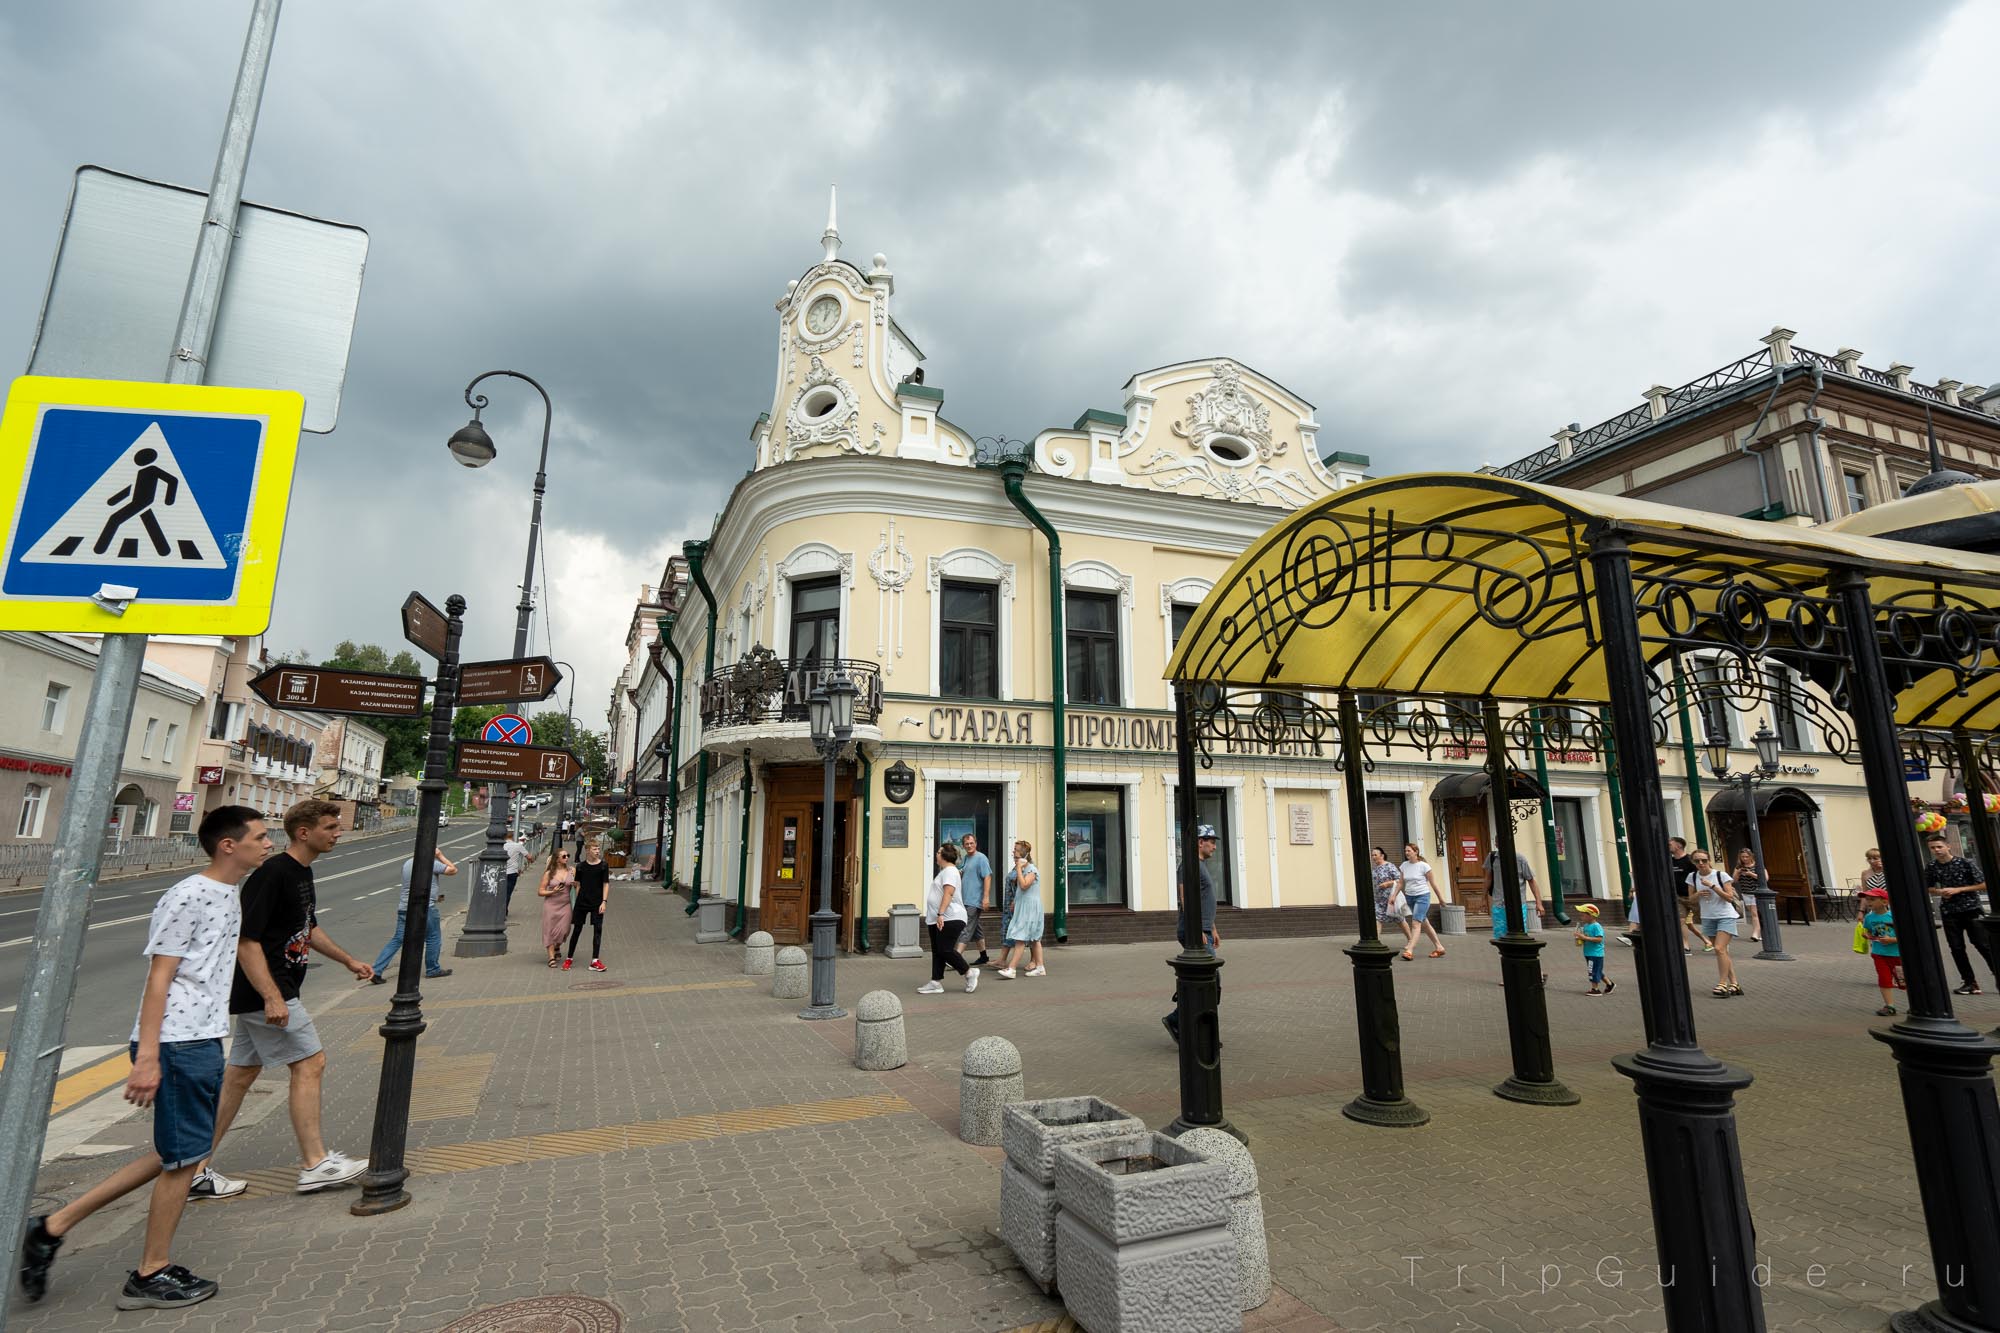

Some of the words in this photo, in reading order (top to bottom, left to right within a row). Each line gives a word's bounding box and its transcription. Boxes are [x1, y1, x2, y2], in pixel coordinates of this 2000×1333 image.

[340, 679, 377, 687] КАЗАНСКИЙ
[377, 682, 417, 690] УНИВЕРСИТЕТ
[370, 691, 417, 700] УНИВЕРСИТЕТЫ
[929, 707, 1033, 744] СТАРАЯ
[480, 749, 520, 757] ПЕТЕРБУРГСКАЯ
[1549, 752, 1594, 762] EXCRSIONS
